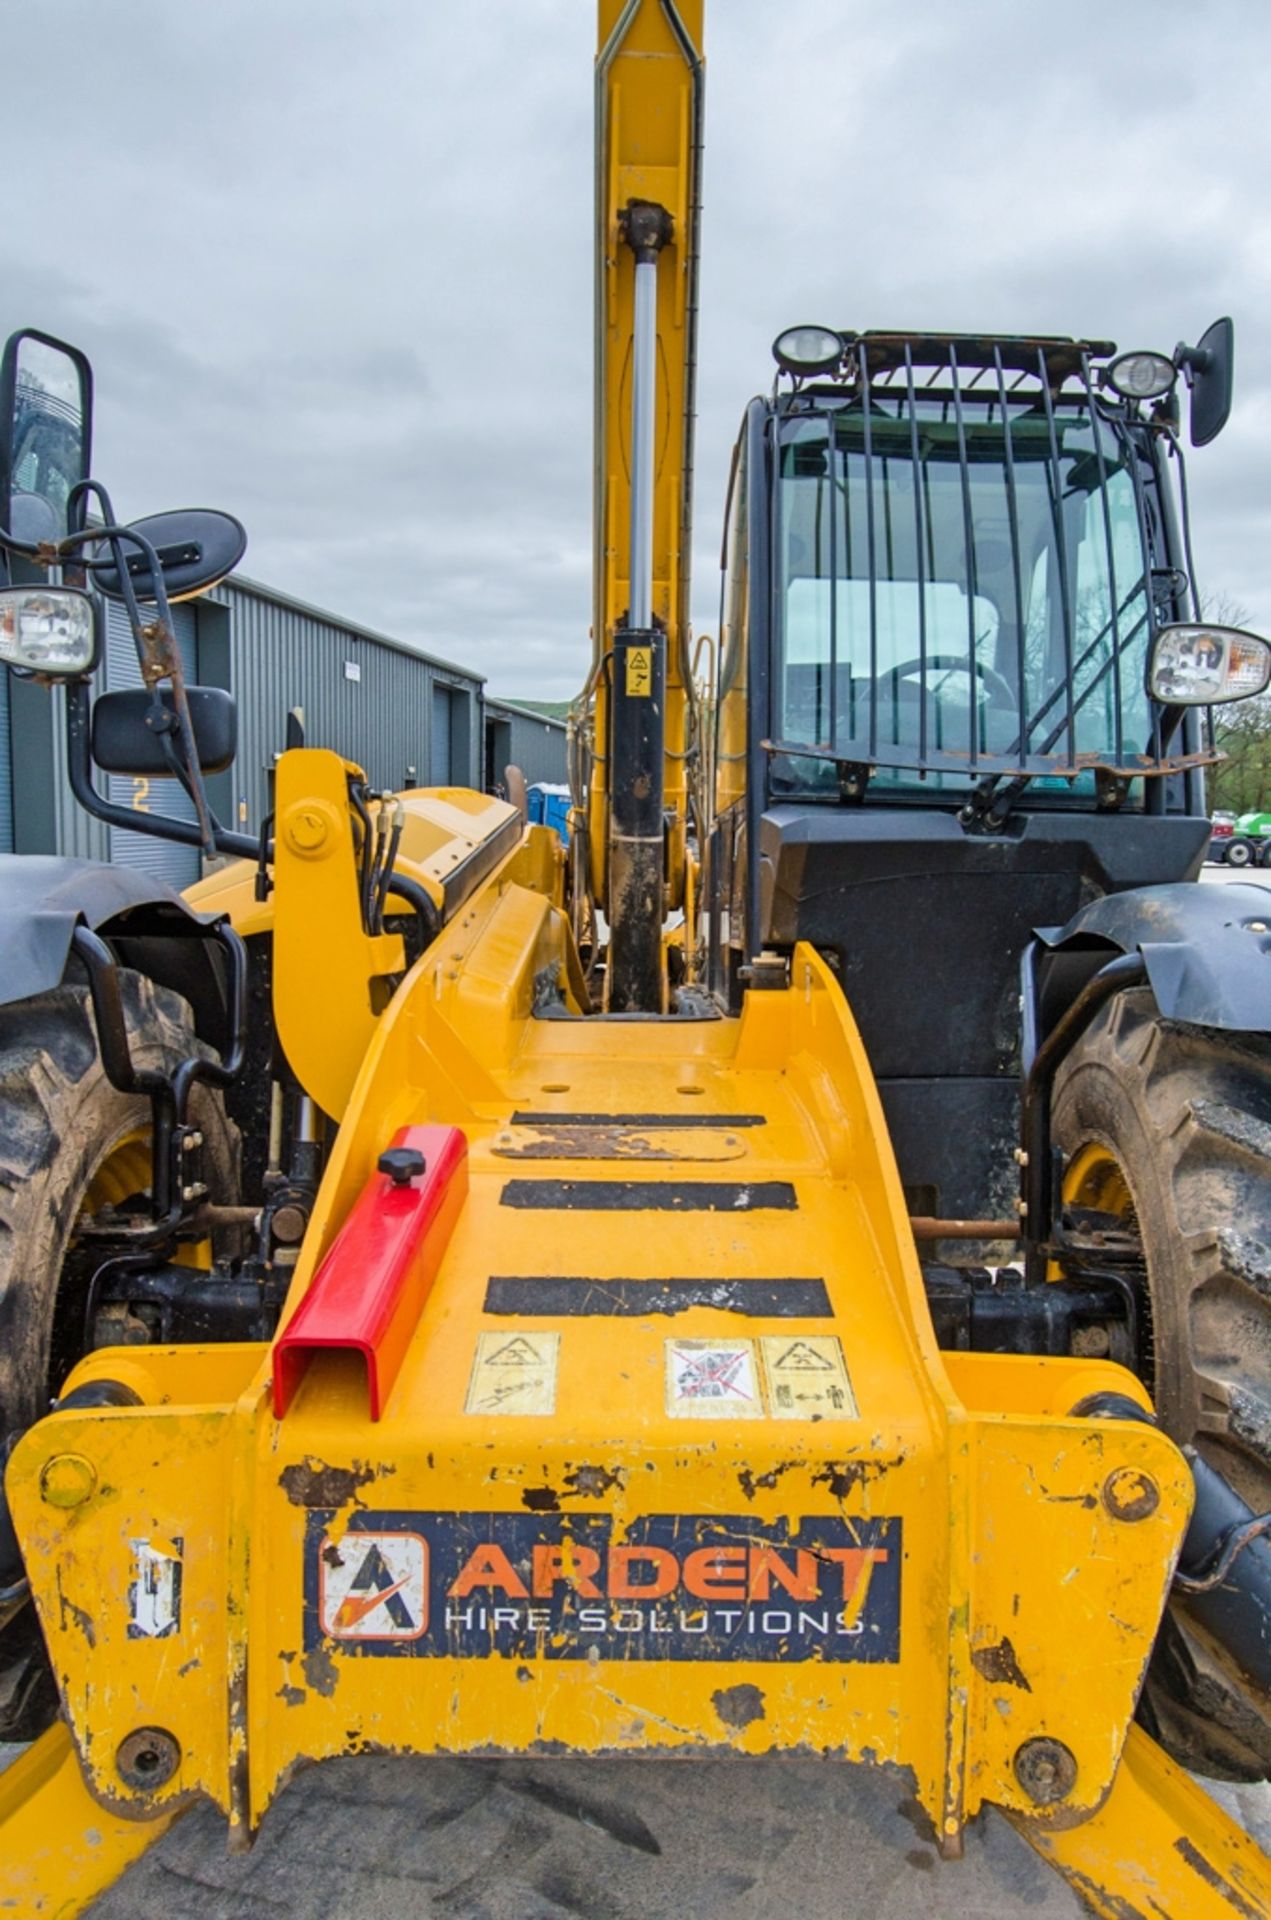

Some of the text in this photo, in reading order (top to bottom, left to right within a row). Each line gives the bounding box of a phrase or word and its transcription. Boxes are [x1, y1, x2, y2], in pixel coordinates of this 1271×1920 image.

[131, 776, 149, 812] 2
[446, 1543, 888, 1602] ARDENT
[444, 1607, 865, 1634] HIRE SOLUTIONS
